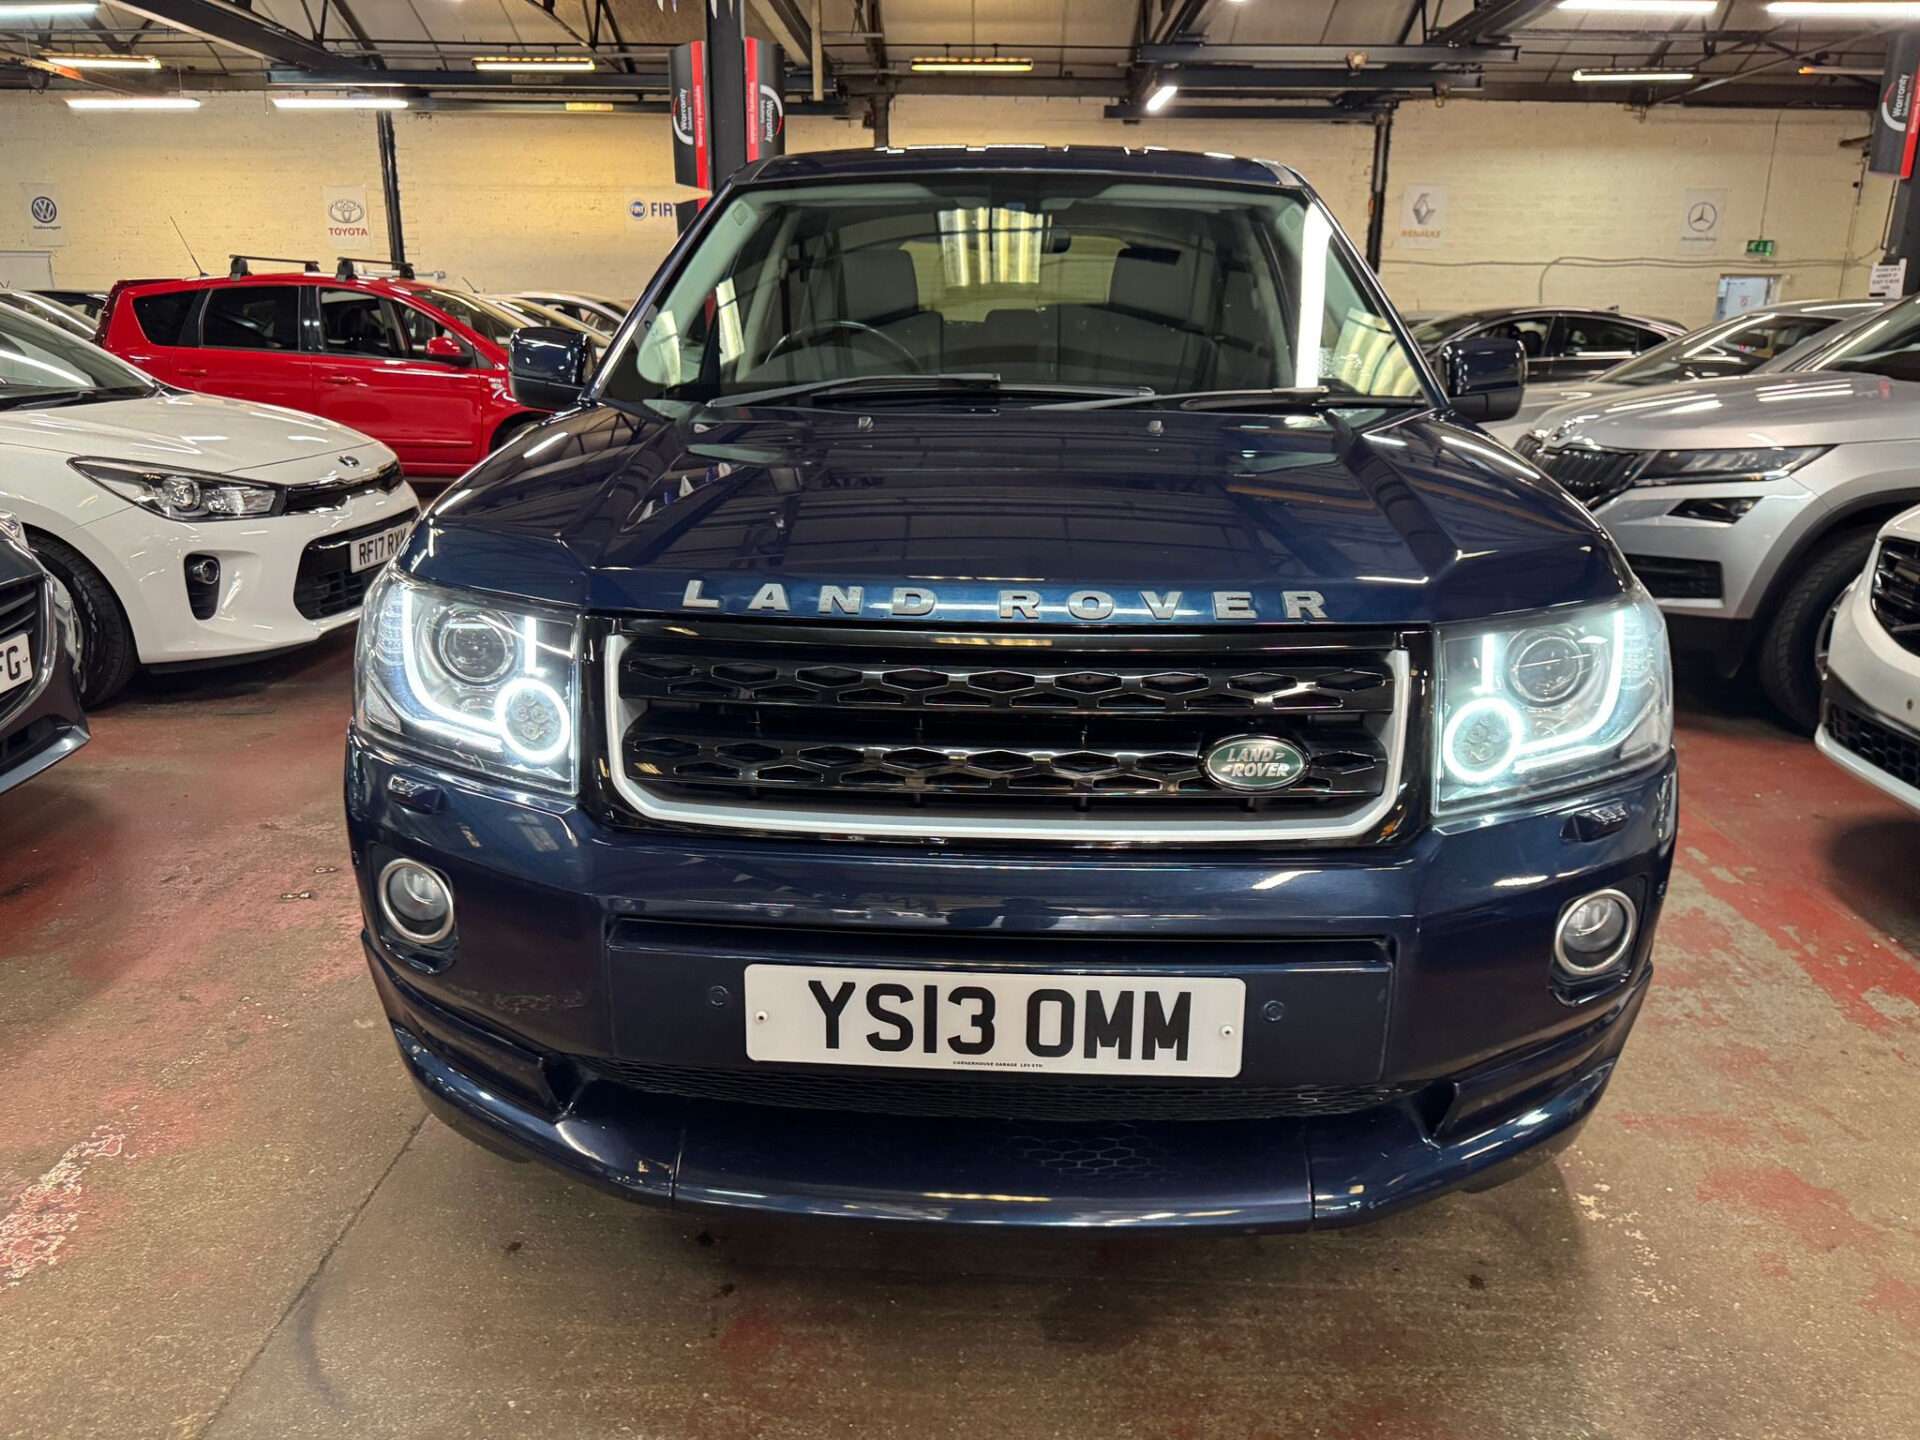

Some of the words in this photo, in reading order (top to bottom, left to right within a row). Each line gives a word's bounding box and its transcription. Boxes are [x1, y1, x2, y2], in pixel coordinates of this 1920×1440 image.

[680, 88, 688, 131] Warranty
[1892, 74, 1910, 117] Warranty
[765, 100, 774, 142] Warranty
[651, 202, 676, 217] FIA
[328, 227, 368, 236] TOYOTA
[359, 536, 385, 566] RF17
[682, 579, 938, 616] LAND
[999, 590, 1328, 620] ROVER
[0, 645, 20, 680] G
[1227, 747, 1275, 762] LAND
[1231, 762, 1291, 777] ROVER
[808, 980, 996, 1055] YS13
[1026, 988, 1192, 1061] OMM
